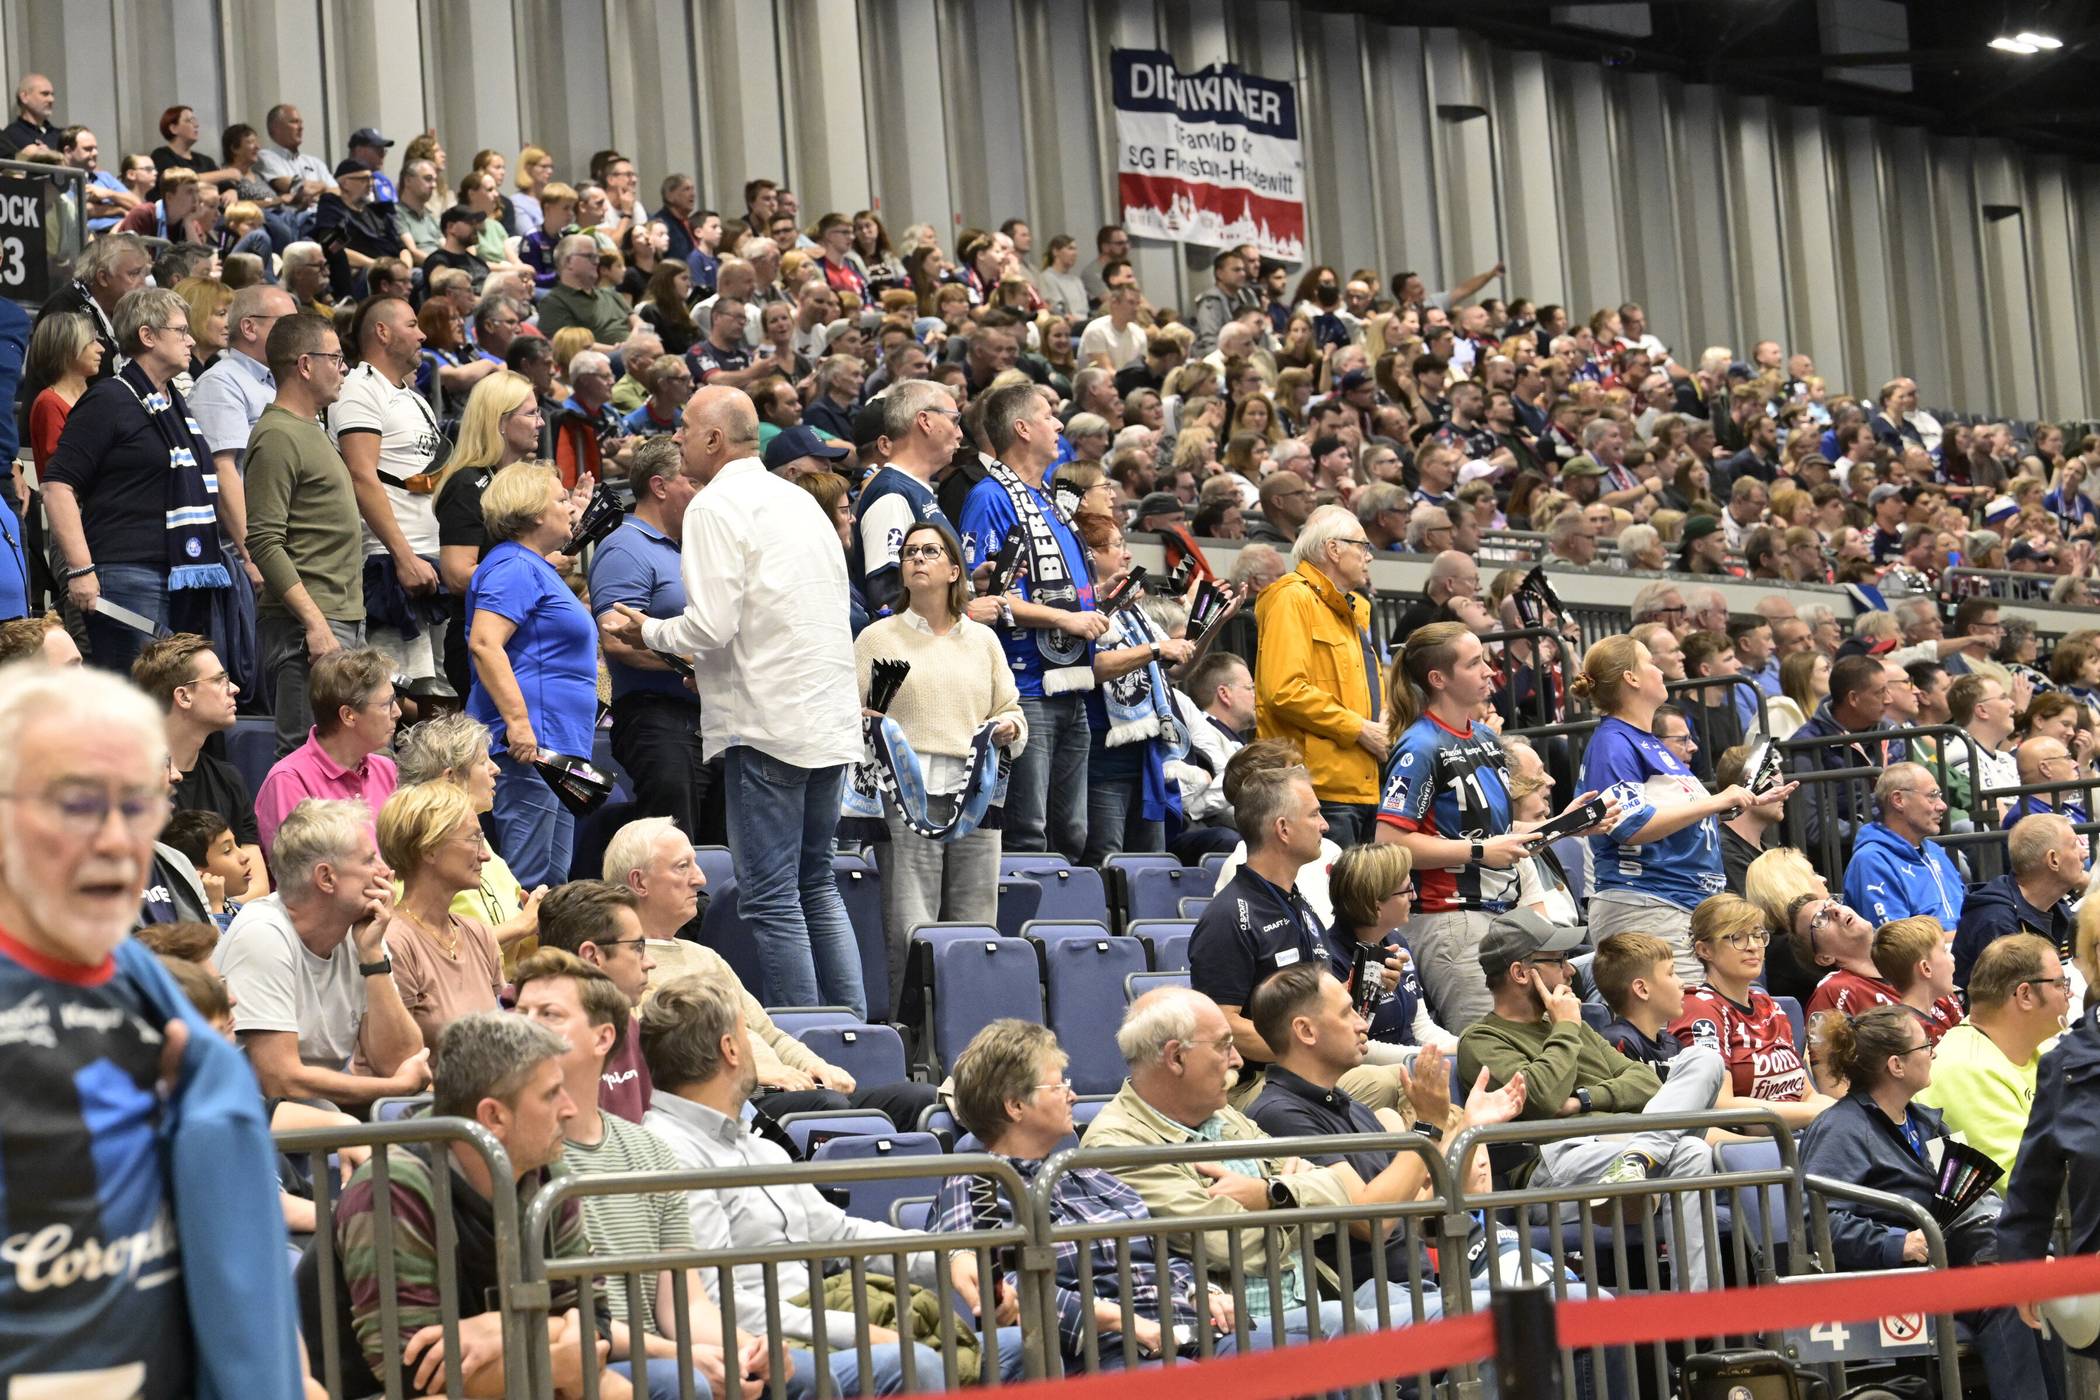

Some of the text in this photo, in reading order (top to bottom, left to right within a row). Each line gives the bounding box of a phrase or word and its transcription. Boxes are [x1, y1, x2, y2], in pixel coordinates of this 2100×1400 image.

[1129, 145, 1155, 170] SG
[0, 237, 26, 286] 3
[1417, 774, 1434, 819] VORWERK
[1446, 773, 1489, 812] 11
[1622, 799, 1641, 812] DKB
[1262, 920, 1283, 933] CRAFT
[1809, 1320, 1851, 1351] 4
